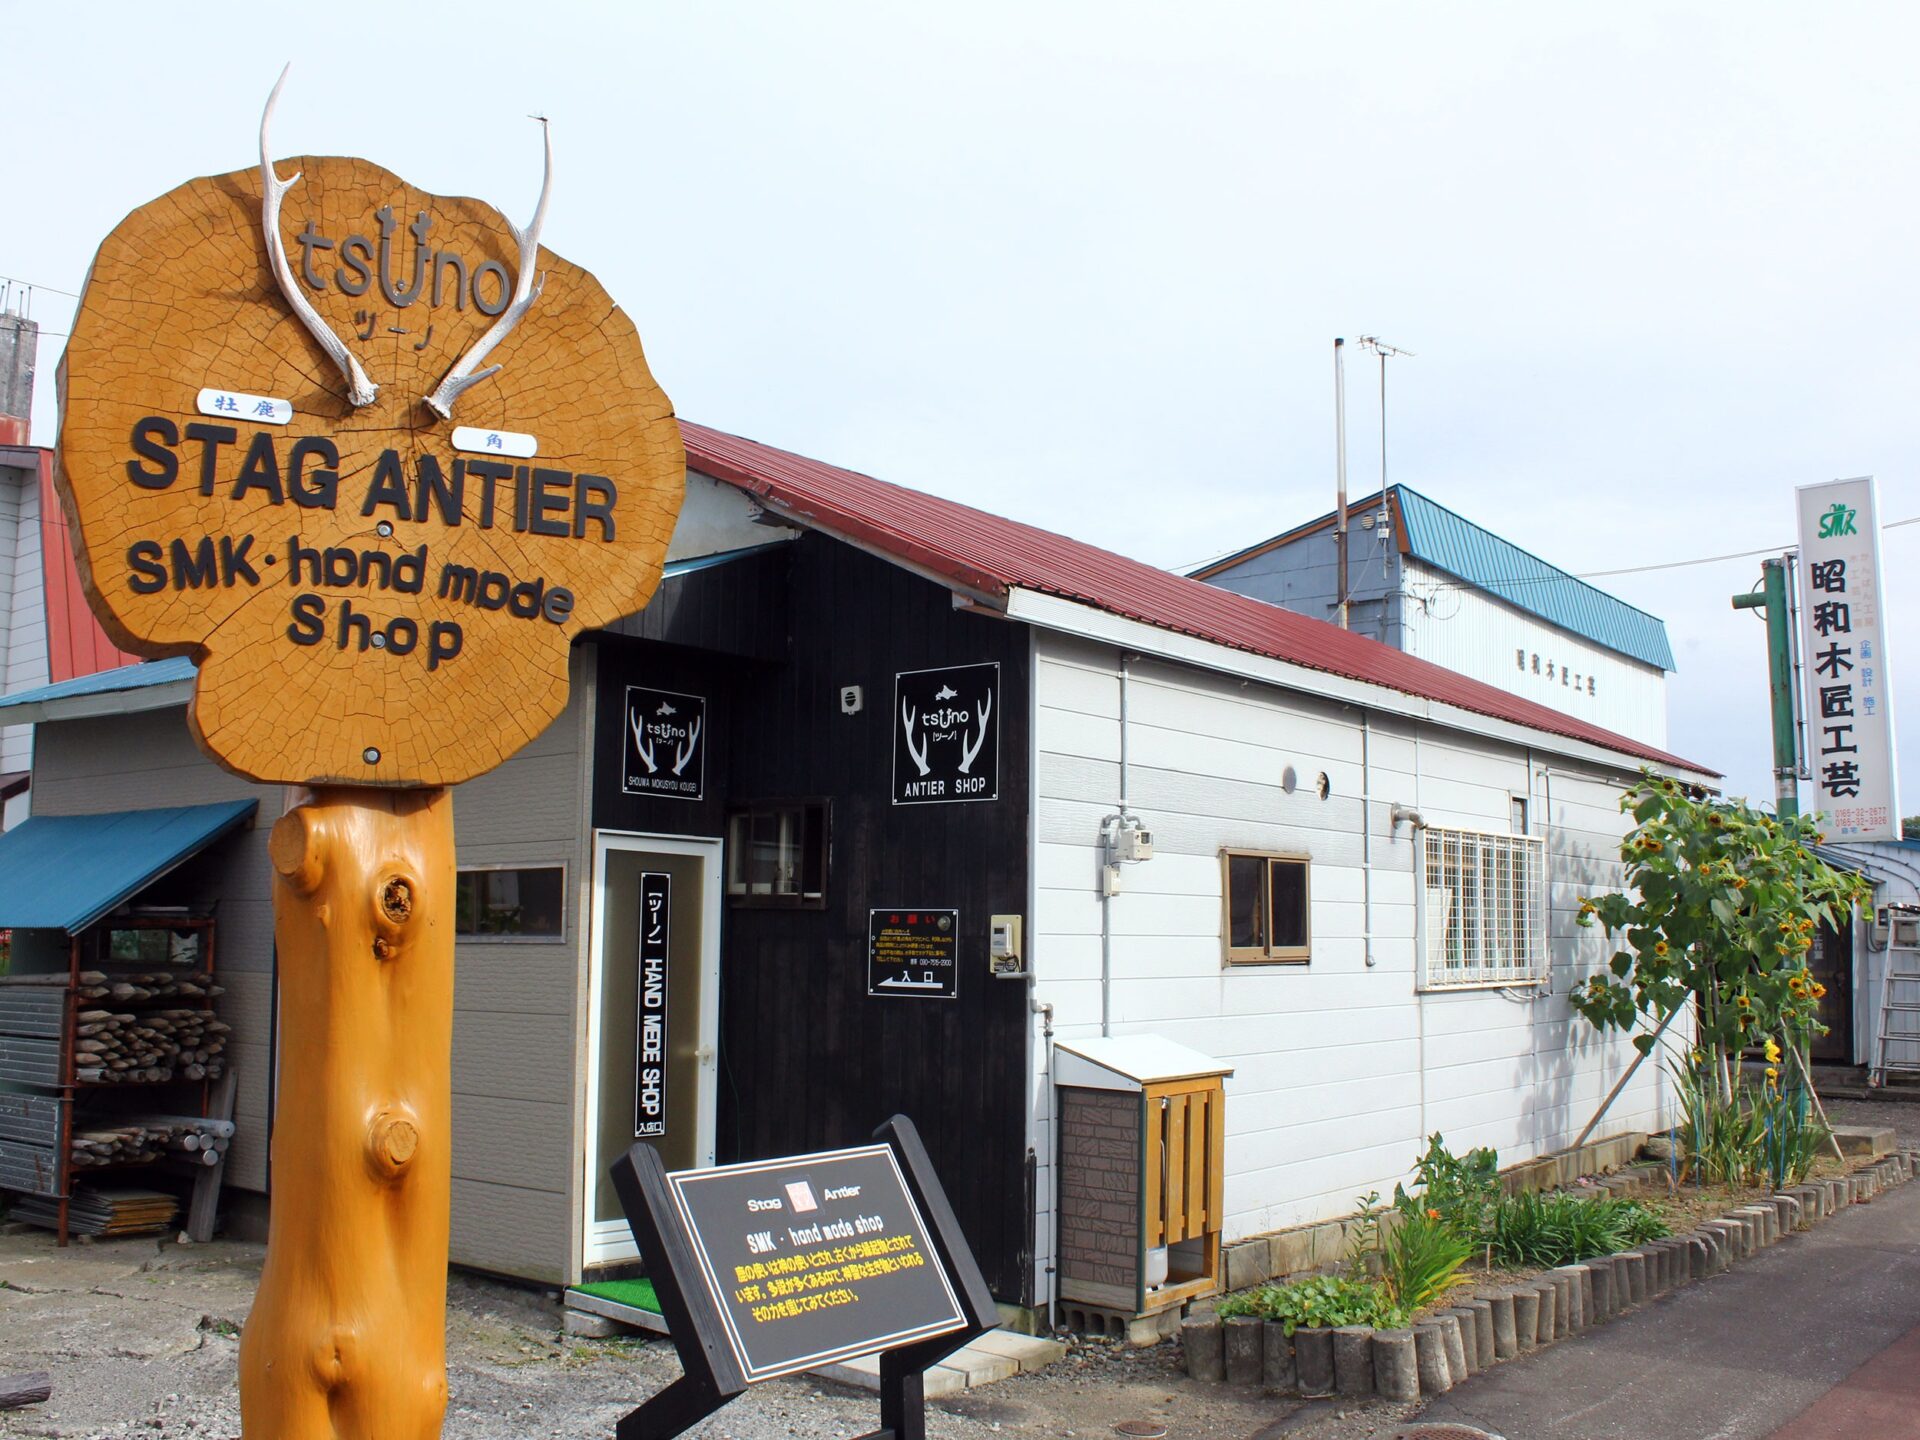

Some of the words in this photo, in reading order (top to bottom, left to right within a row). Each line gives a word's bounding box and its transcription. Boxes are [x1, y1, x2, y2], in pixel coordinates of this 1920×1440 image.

[485, 432, 504, 450] 角
[127, 416, 340, 510] STAG
[361, 448, 618, 542] ANTIER
[288, 594, 463, 671] Shop
[1811, 558, 1861, 799] 昭和木匠工芸
[905, 781, 945, 797] ANTIER
[955, 777, 986, 793] SHOP
[644, 958, 663, 1008] HAND
[642, 1015, 662, 1062] MEDE
[641, 1068, 661, 1116] SHOP
[747, 1198, 782, 1212] Stag
[746, 1231, 777, 1254] SMK
[788, 1223, 821, 1246] hand
[823, 1218, 855, 1240] made
[855, 1214, 884, 1234] shop
